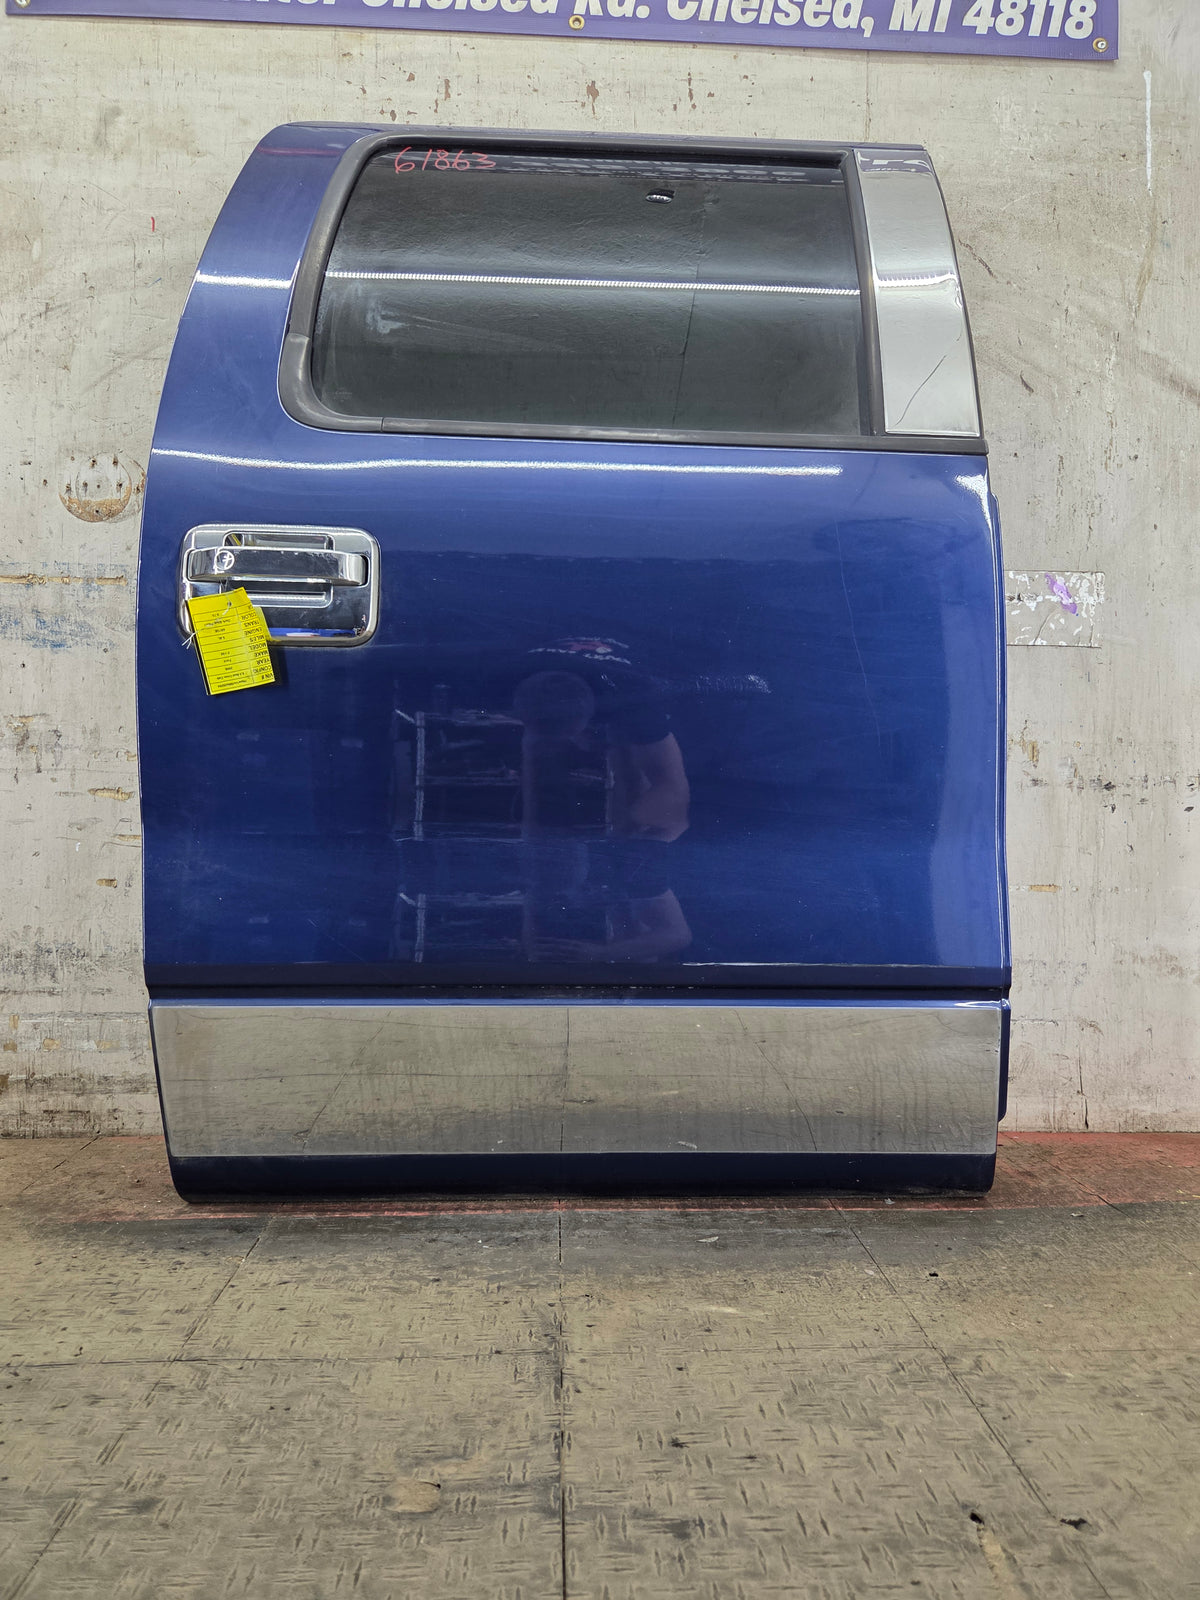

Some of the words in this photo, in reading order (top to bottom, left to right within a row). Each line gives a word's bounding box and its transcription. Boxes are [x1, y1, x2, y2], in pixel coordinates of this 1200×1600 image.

[888, 0, 951, 33] MI
[962, 0, 1097, 40] 48118
[394, 147, 497, 174] 61863
